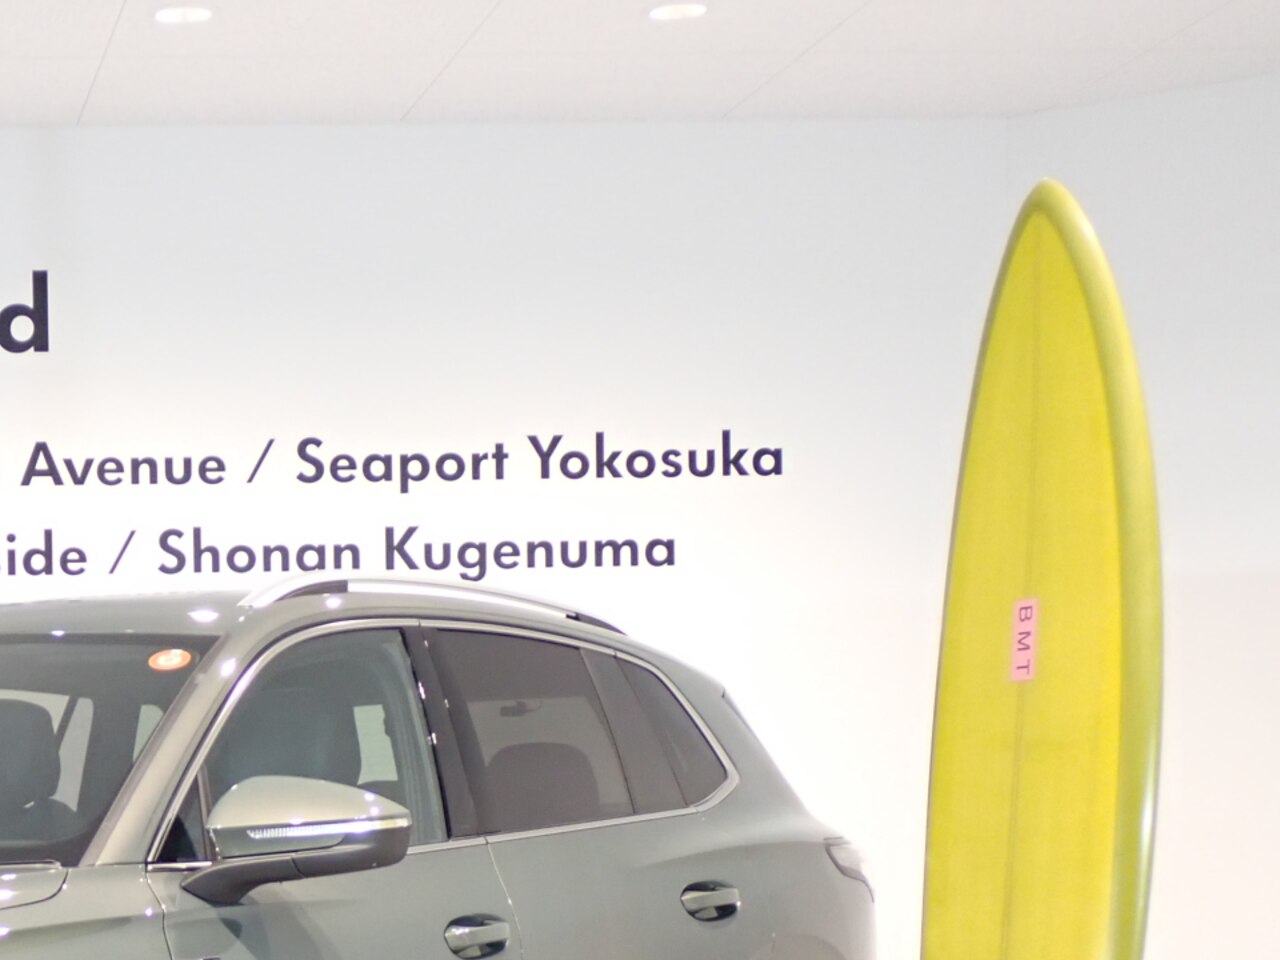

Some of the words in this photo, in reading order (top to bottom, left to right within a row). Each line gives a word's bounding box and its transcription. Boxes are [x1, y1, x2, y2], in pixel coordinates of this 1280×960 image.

[21, 442, 226, 486] Avenue
[247, 439, 274, 483] /
[296, 437, 509, 494] Seaport
[527, 429, 783, 480] Yokosuka
[109, 531, 135, 574] /
[158, 527, 360, 574] Shonan
[385, 526, 676, 582] Kugenuma
